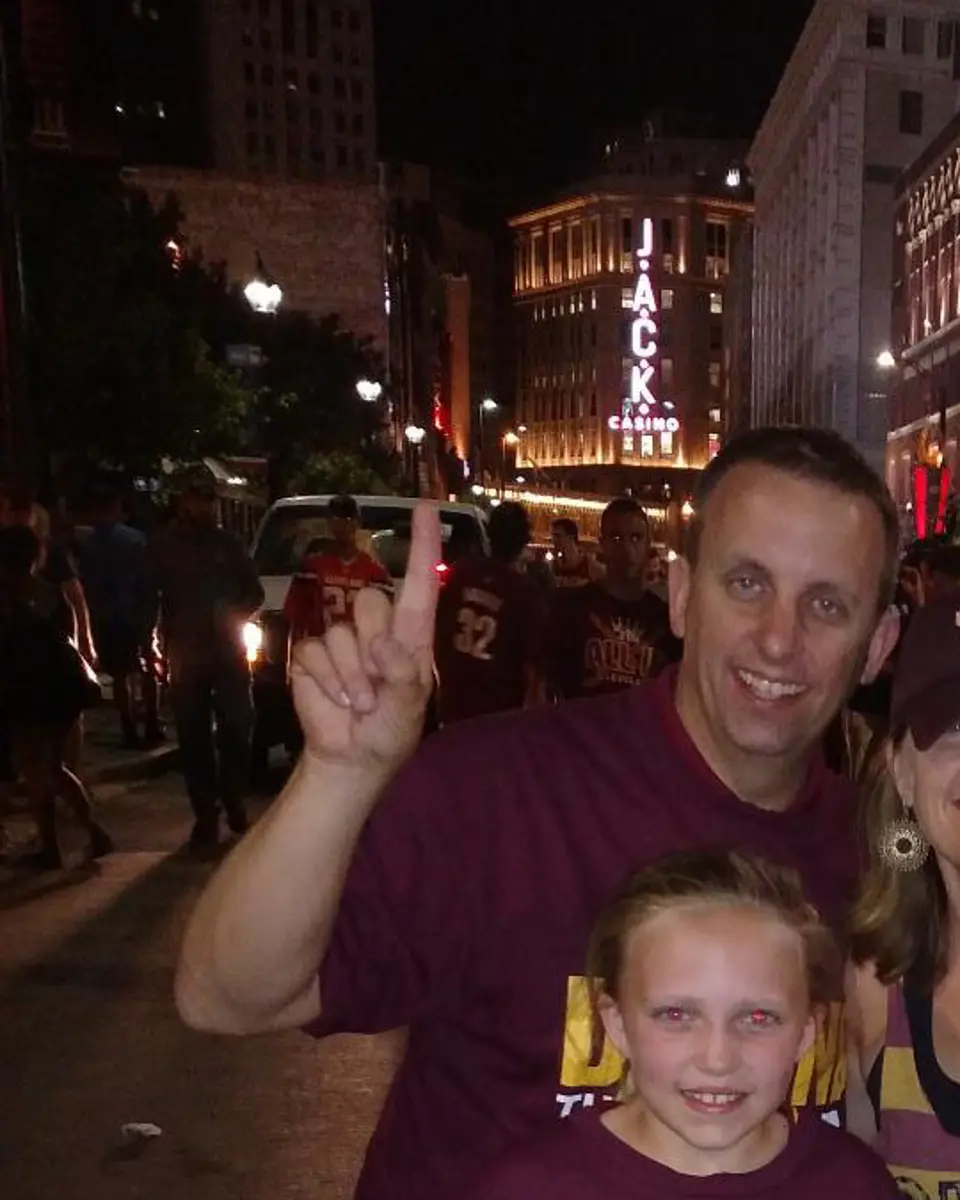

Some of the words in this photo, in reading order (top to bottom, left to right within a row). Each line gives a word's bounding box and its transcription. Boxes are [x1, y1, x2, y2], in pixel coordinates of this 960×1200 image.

[631, 217, 658, 405] JACK
[607, 415, 680, 432] CASINO
[453, 608, 498, 661] 32
